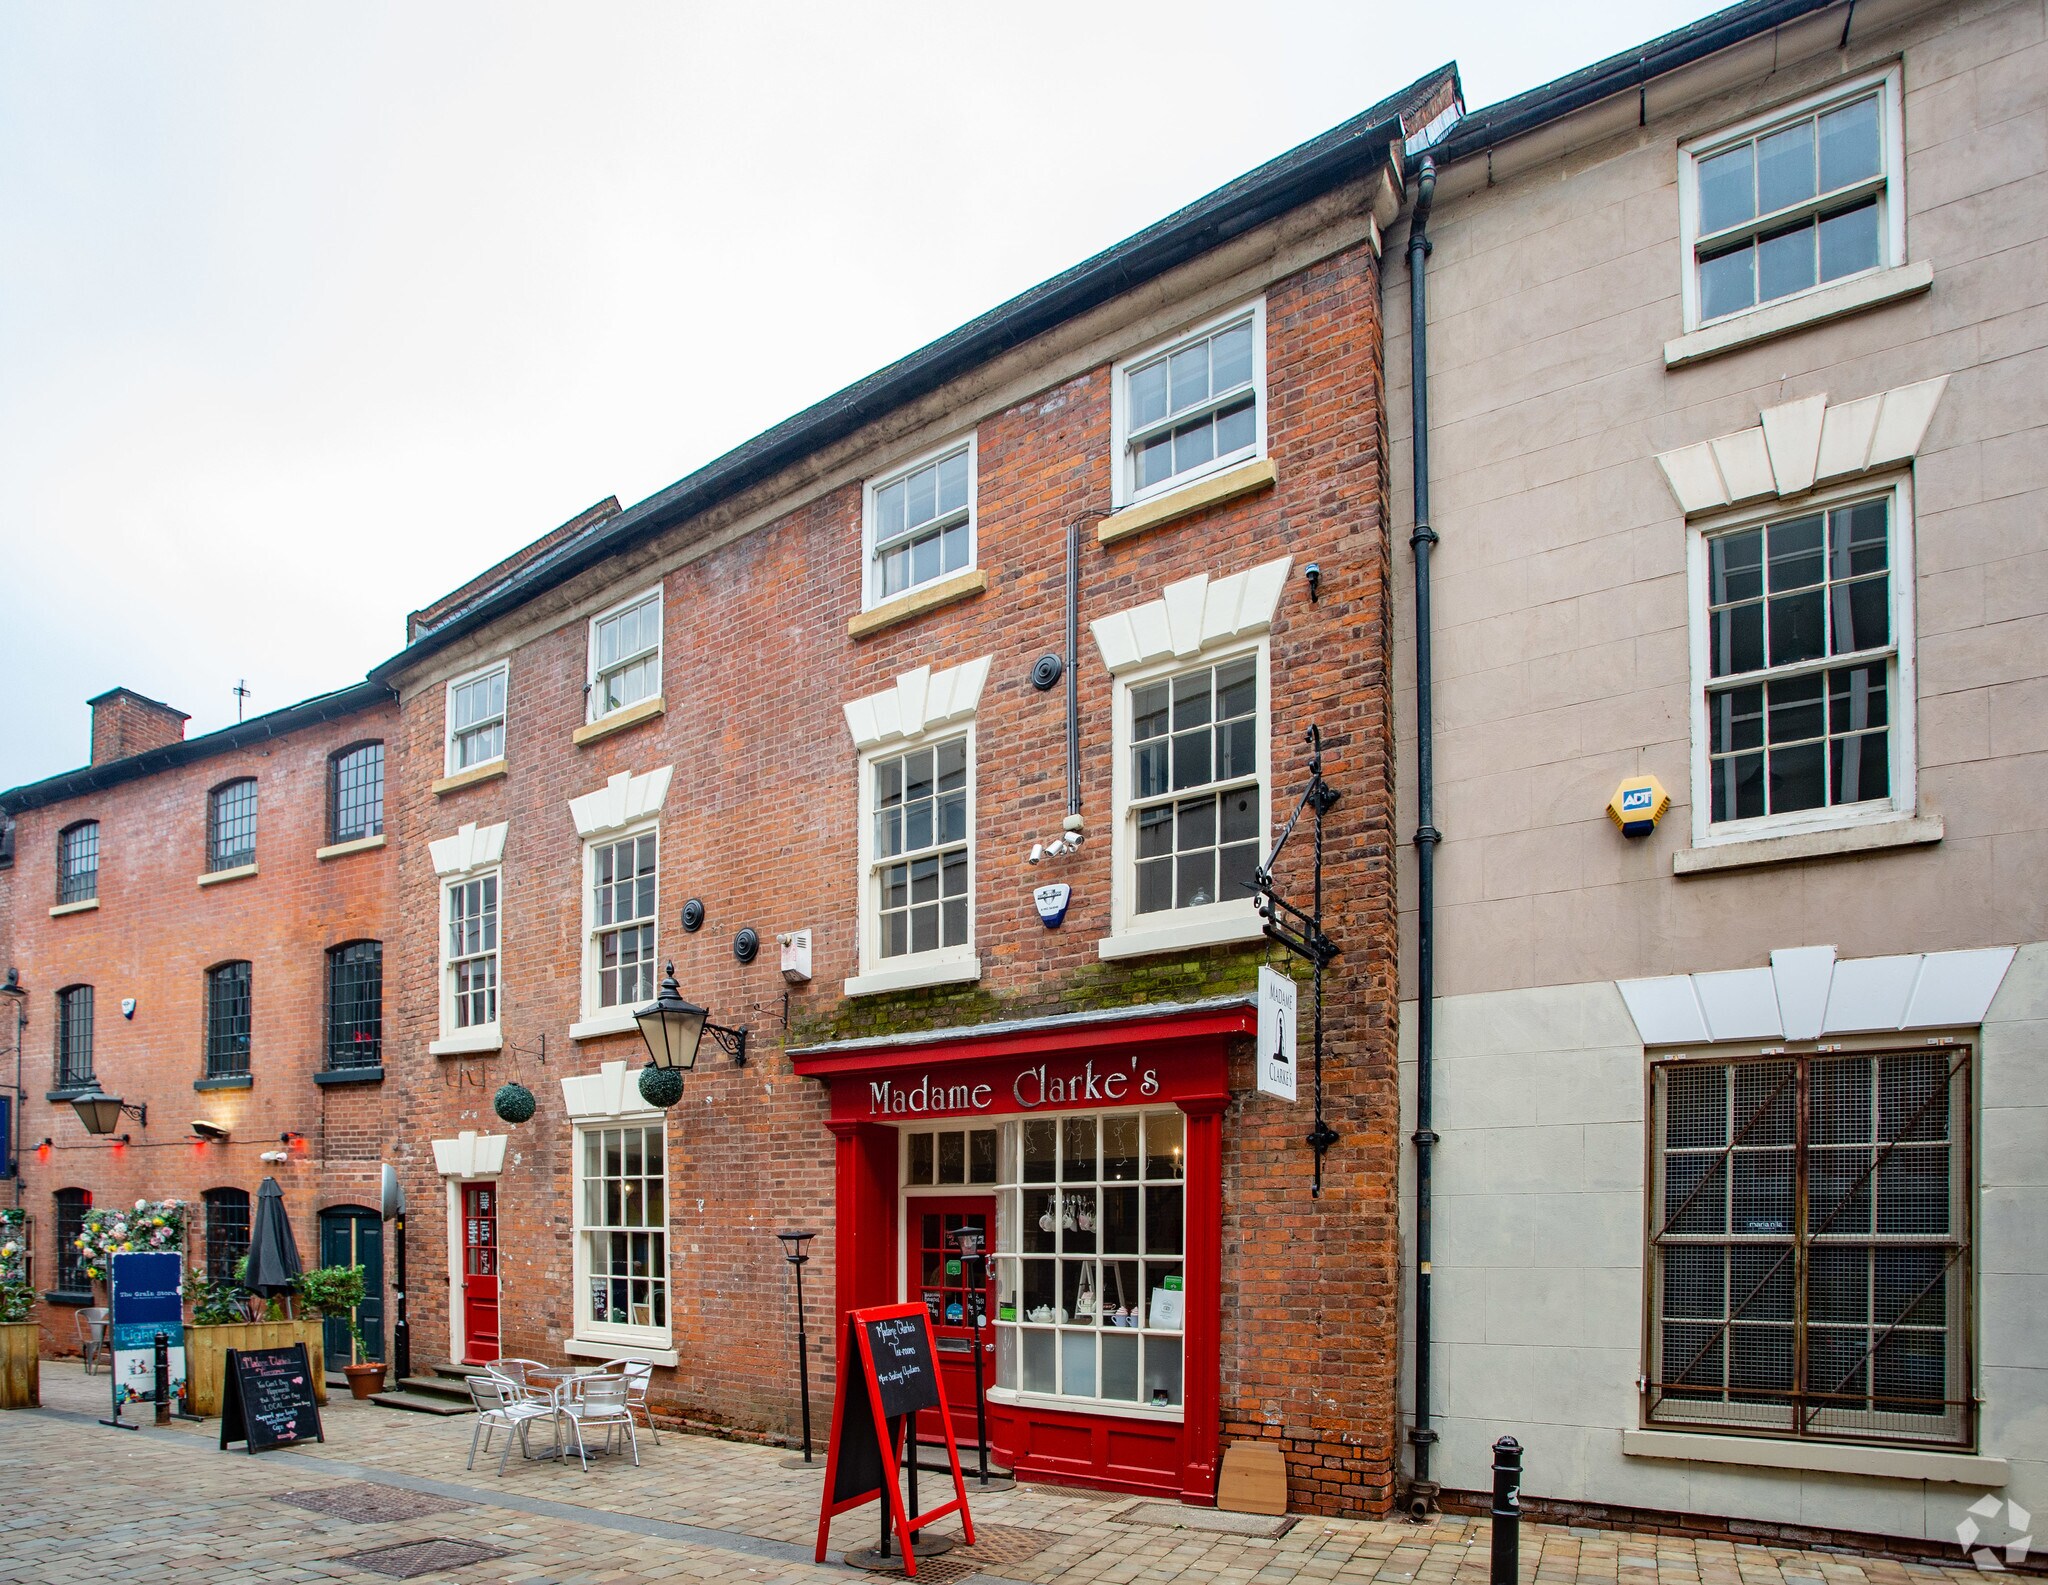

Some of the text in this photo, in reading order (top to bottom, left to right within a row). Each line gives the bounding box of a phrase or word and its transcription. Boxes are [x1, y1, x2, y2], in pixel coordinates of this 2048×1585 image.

[1623, 791, 1652, 807] ADT
[1269, 981, 1293, 1010] MADAME
[869, 1055, 1160, 1115] Madame Clarke's
[1269, 1062, 1293, 1088] CLARKE'S
